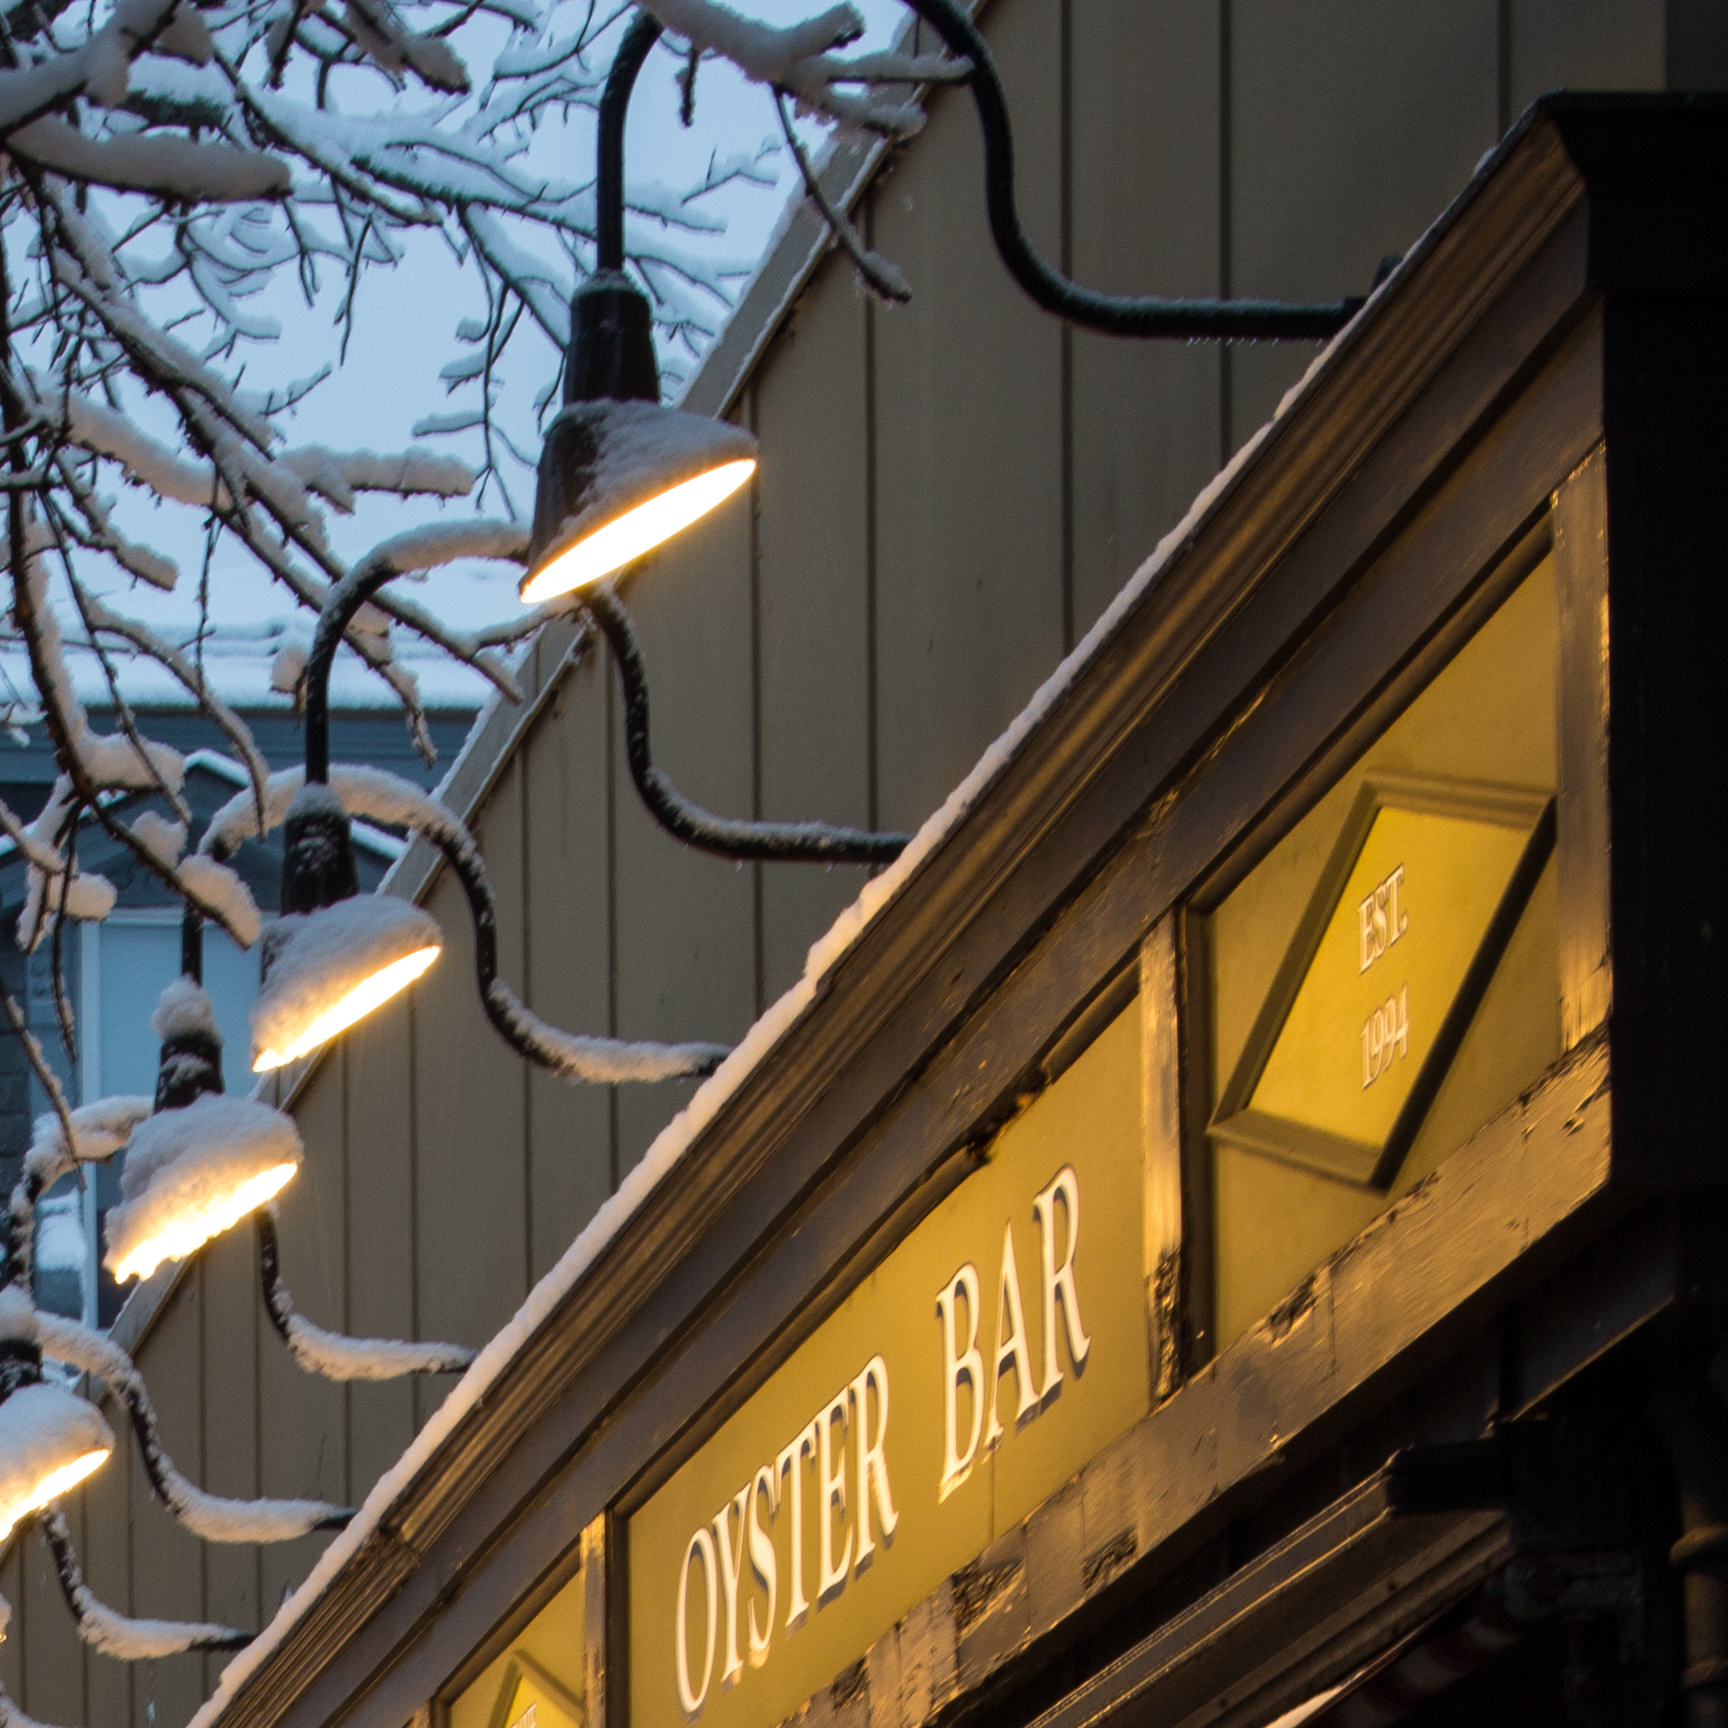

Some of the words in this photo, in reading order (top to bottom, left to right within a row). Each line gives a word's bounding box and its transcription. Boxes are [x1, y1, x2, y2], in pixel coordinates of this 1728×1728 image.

[1358, 863, 1410, 976] EST.
[1360, 981, 1411, 1090] 1994
[675, 1352, 899, 1713] OYSTER
[935, 1164, 1092, 1502] BAR
